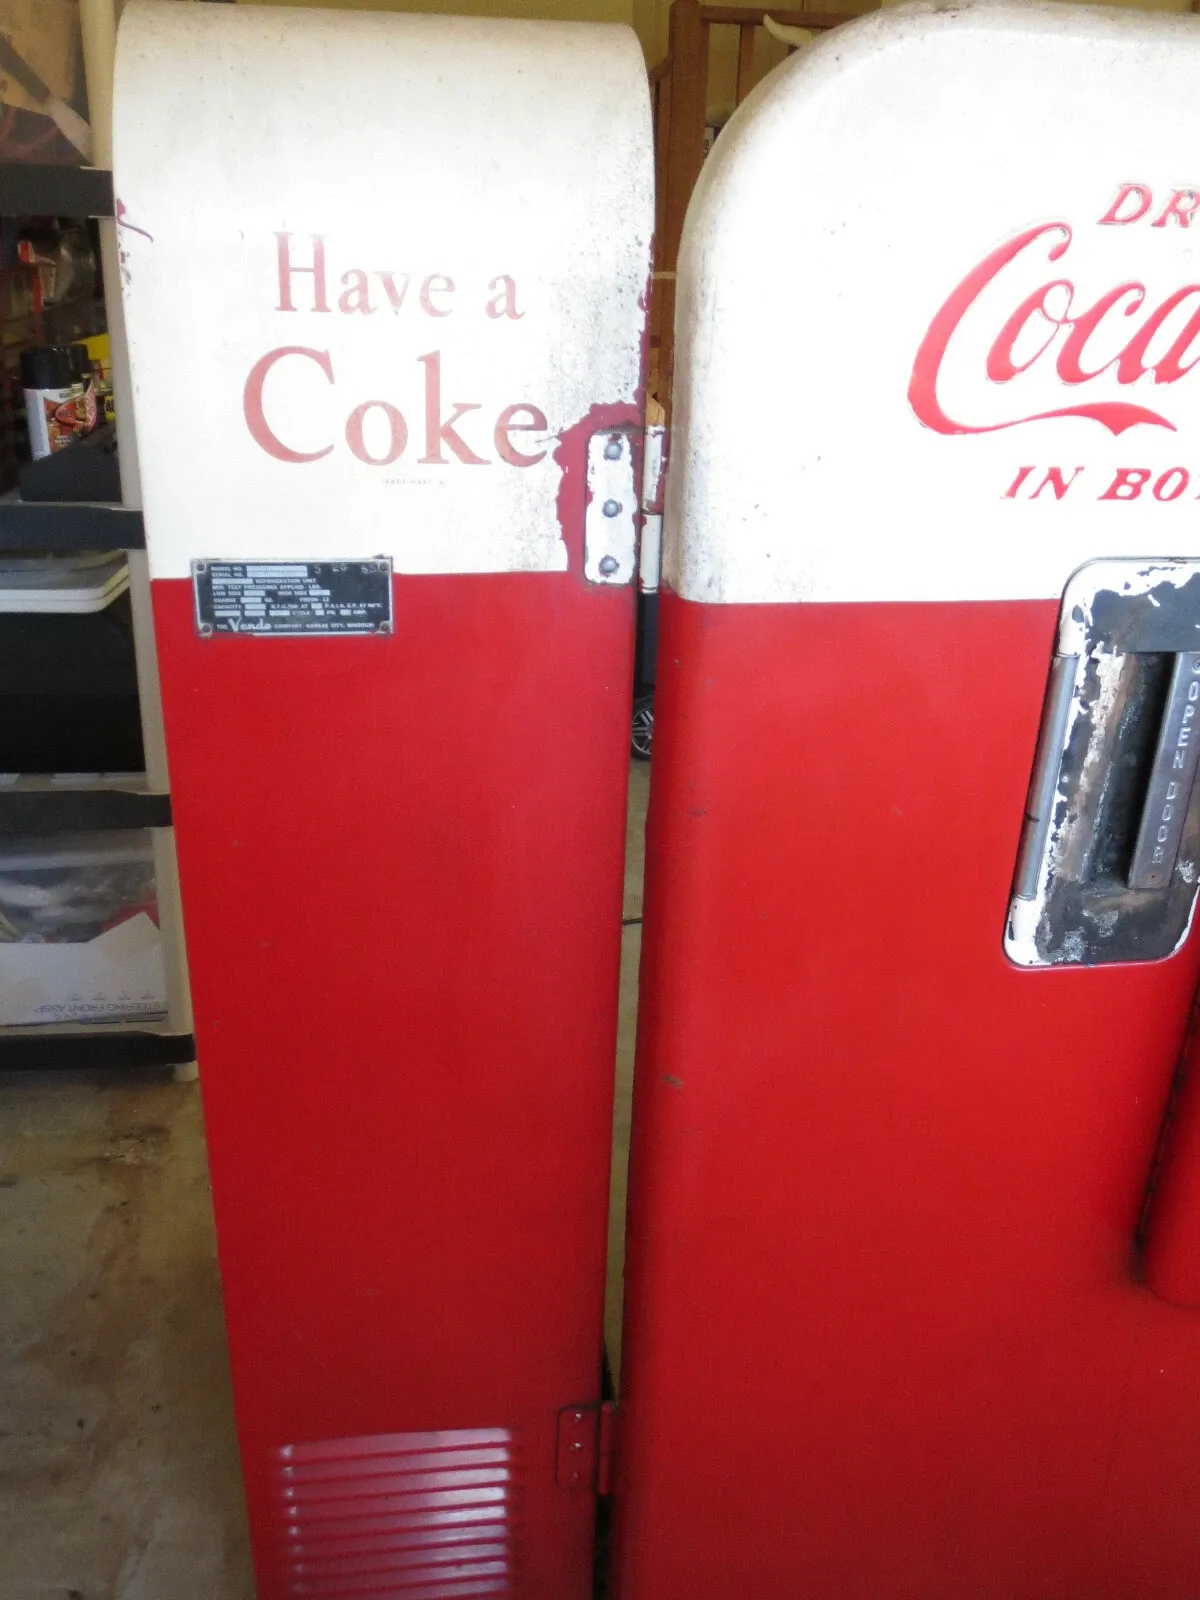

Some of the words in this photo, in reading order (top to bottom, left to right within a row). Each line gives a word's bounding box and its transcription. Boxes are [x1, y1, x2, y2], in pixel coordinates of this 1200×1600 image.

[273, 231, 457, 318] Have
[485, 273, 525, 320] a
[243, 345, 549, 468] Coke
[1000, 466, 1085, 501] IN
[1096, 466, 1200, 502] BO
[228, 617, 272, 632] Vendo
[1172, 681, 1200, 769] OPEN
[1152, 780, 1178, 864] DOOR
